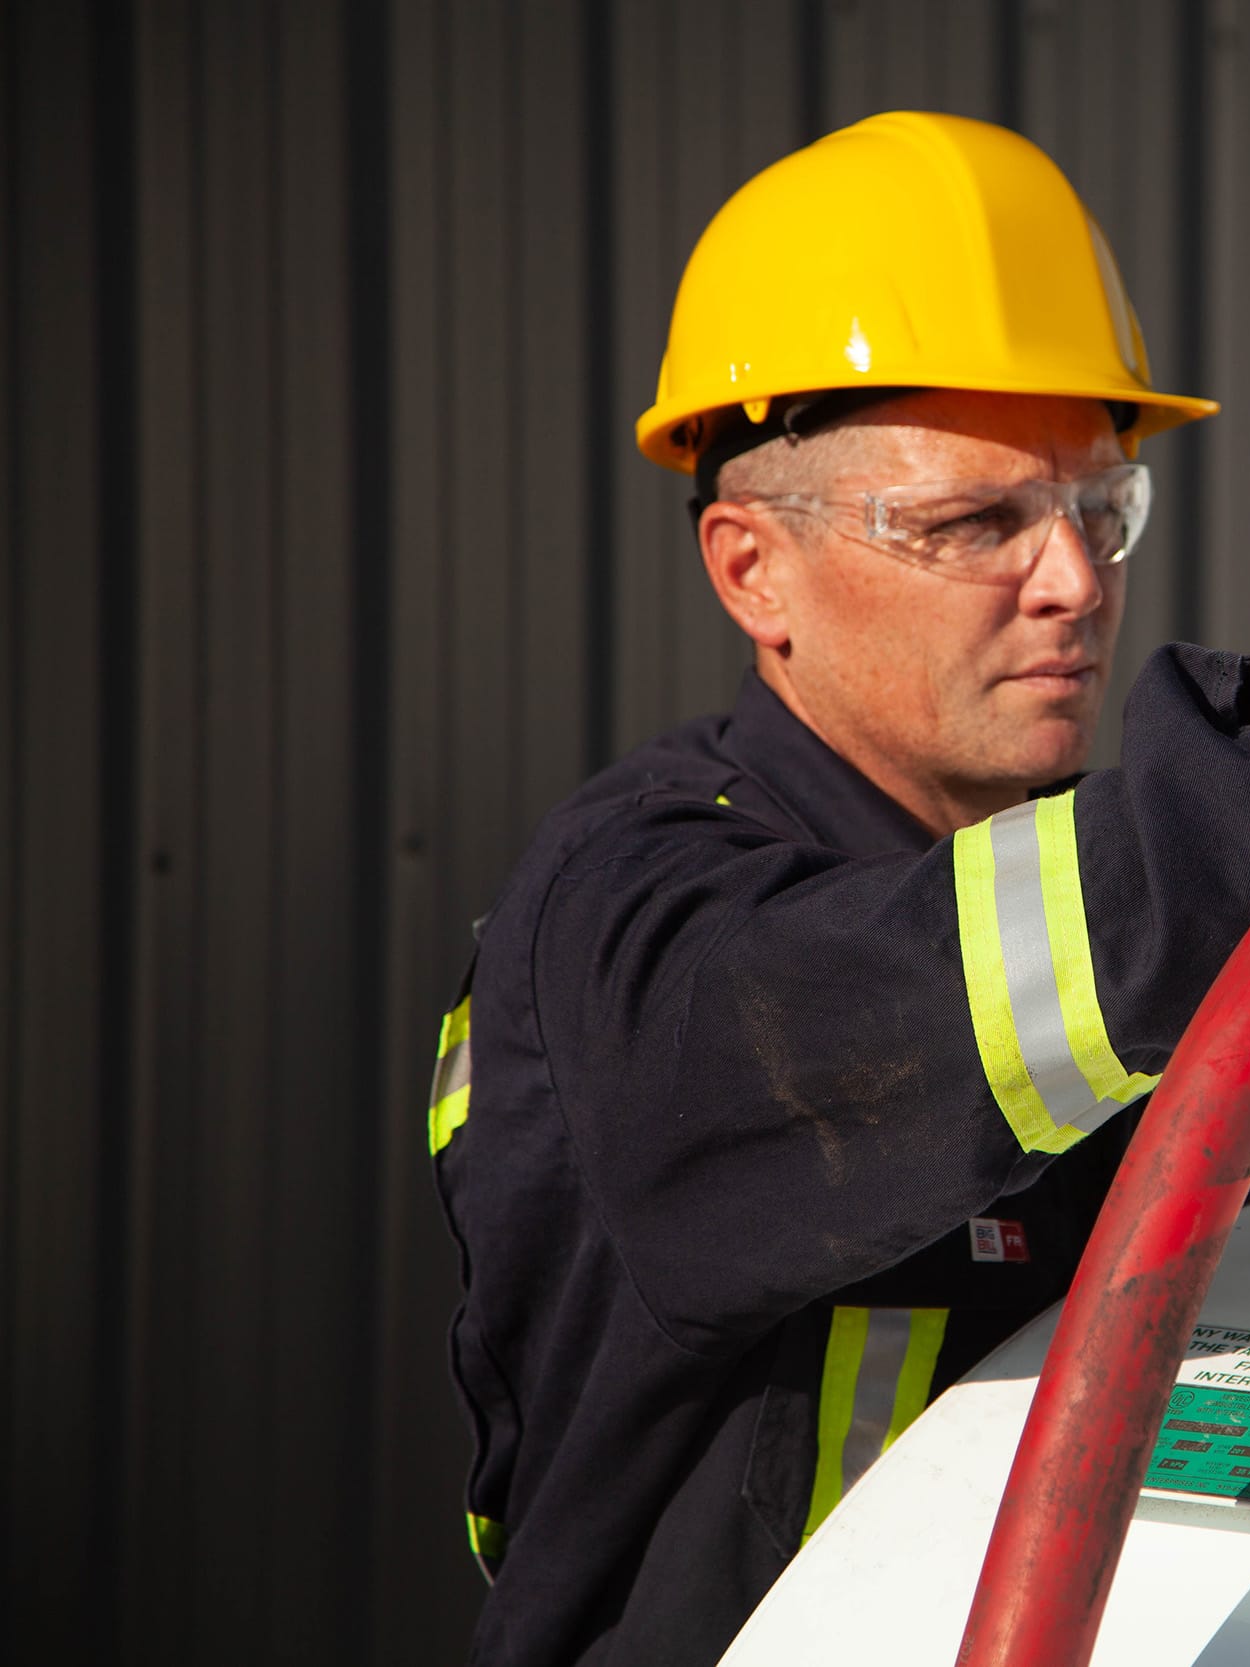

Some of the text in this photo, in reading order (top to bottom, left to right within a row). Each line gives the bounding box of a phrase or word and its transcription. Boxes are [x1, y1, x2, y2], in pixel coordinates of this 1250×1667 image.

[1005, 1235, 1023, 1247] FR
[1192, 1328, 1220, 1338] NY
[1189, 1341, 1230, 1353] THE
